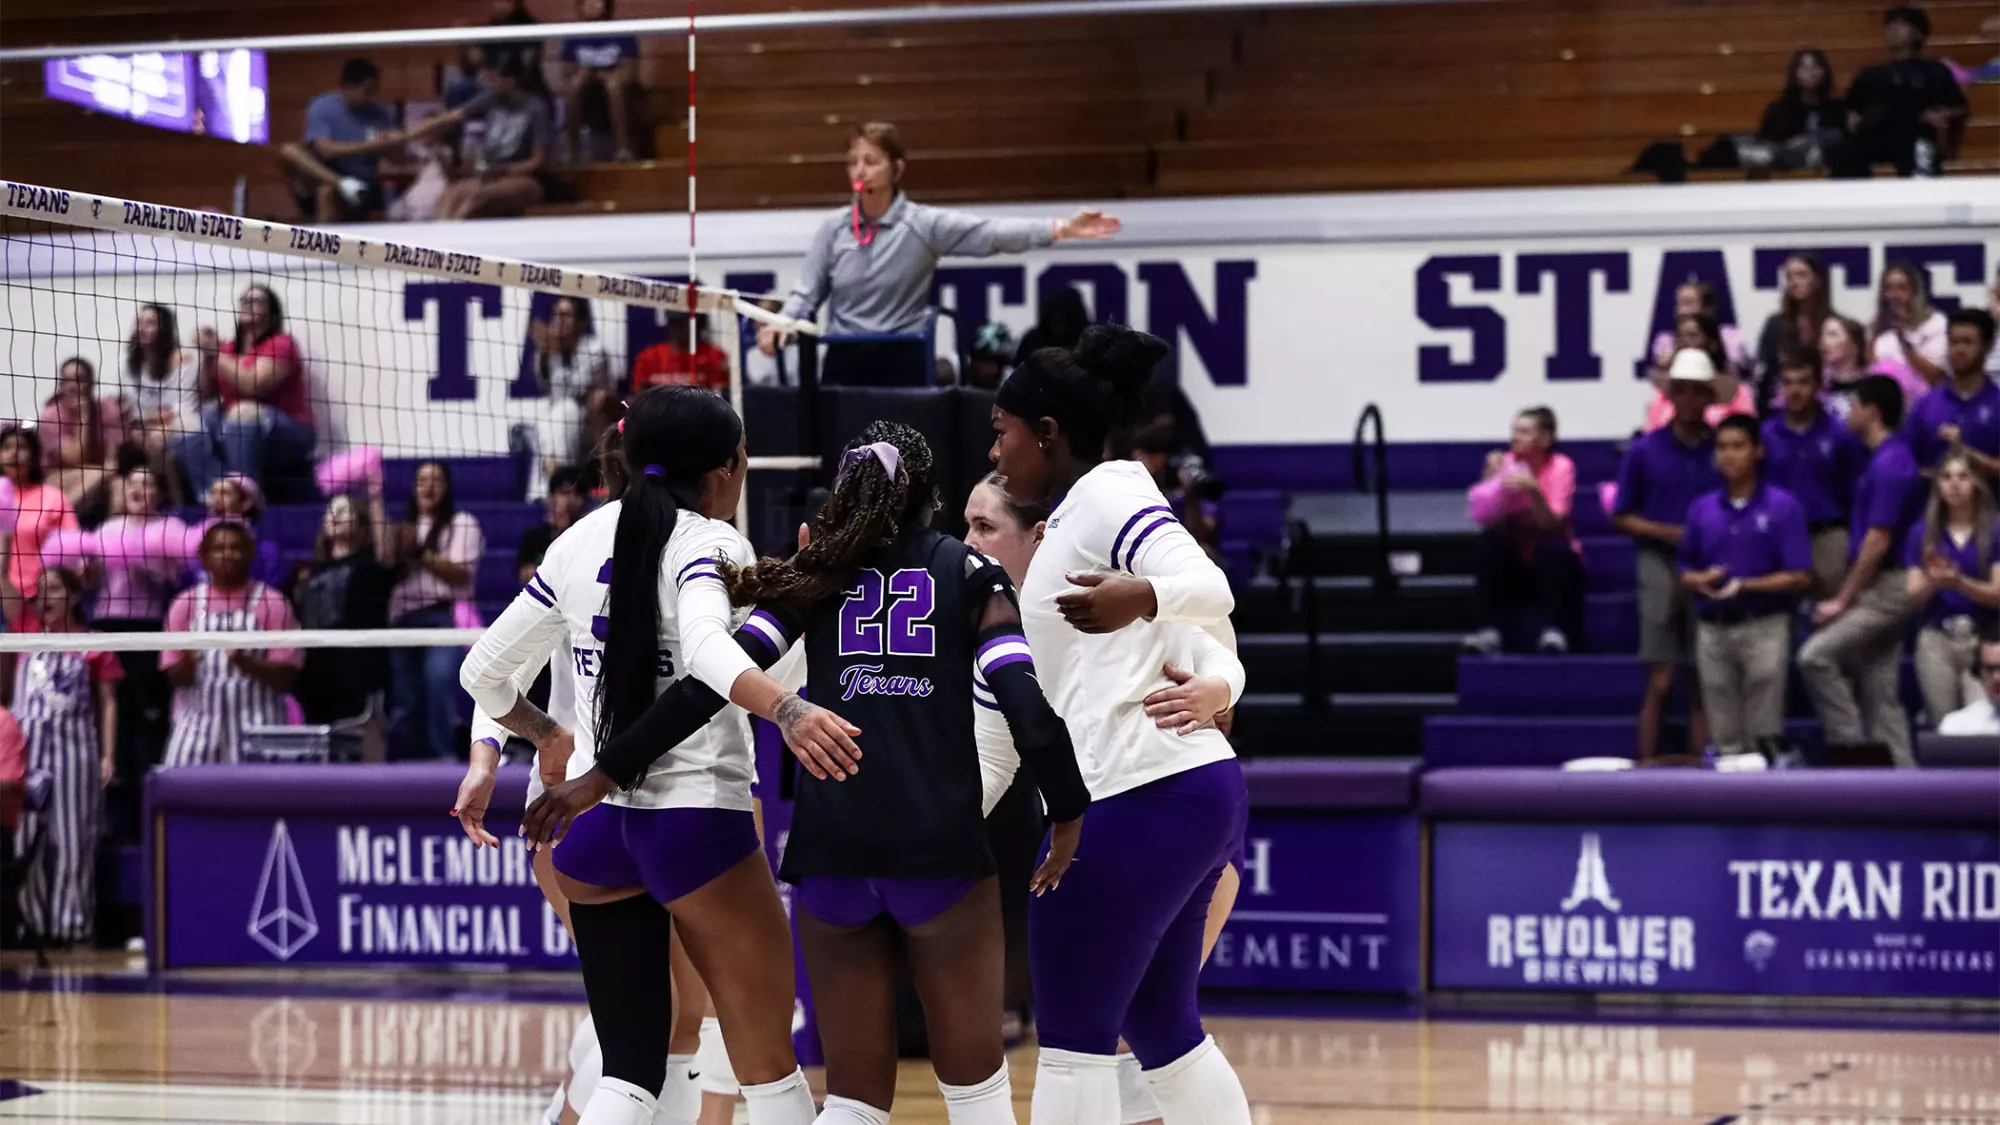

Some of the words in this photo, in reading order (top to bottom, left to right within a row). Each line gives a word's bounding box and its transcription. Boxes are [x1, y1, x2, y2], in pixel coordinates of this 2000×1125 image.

[7, 183, 70, 214] TEXANS
[123, 201, 196, 233] TARLETON
[201, 213, 243, 240] STATE
[289, 227, 341, 254] TEXANS
[384, 242, 444, 270] TARLETON
[445, 252, 482, 275] STATE
[520, 263, 562, 287] TEXANS
[839, 568, 935, 657] 22
[573, 647, 675, 678] TES
[840, 664, 934, 701] Texans
[1728, 860, 1902, 920] TEXAN
[338, 893, 530, 956] FINANCIAL
[1213, 931, 1391, 971] EMENT
[1487, 915, 1696, 971] REVOLVER
[1523, 958, 1659, 985] BREWING
